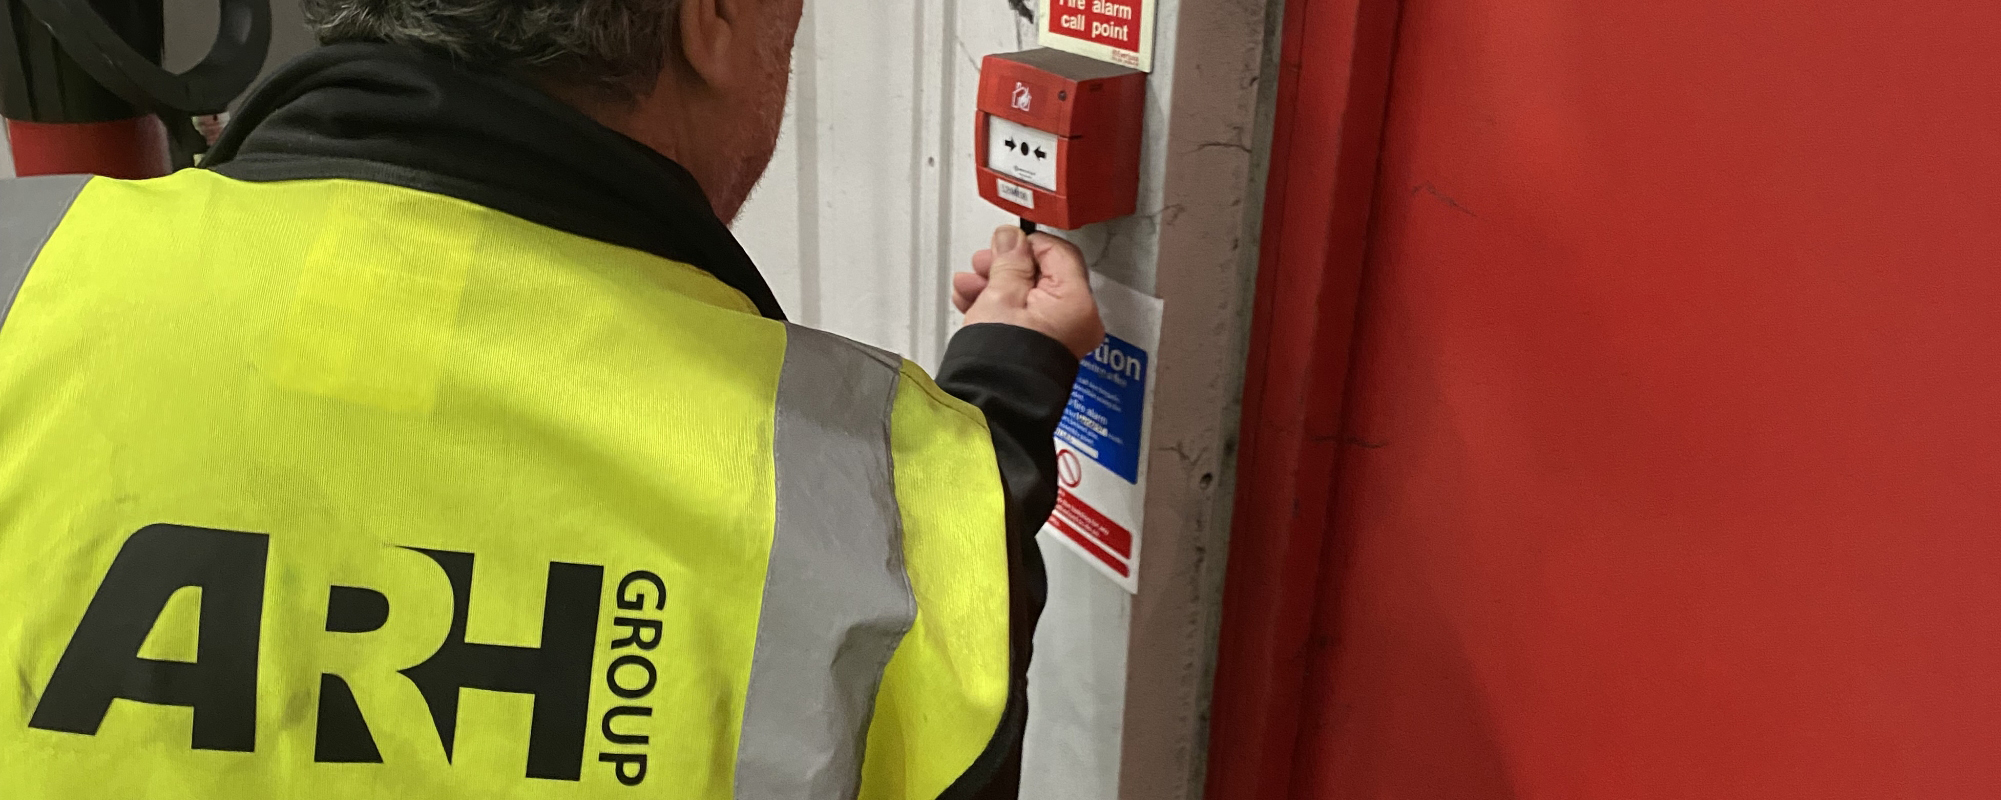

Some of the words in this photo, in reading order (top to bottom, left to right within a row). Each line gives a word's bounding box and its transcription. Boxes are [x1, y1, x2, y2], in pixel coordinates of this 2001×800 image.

[1061, 14, 1085, 31] call
[1091, 21, 1128, 42] point
[1092, 0, 1132, 20] alarm
[1088, 337, 1142, 381] tion
[28, 523, 604, 782] ARH
[598, 570, 667, 787] GROUP
